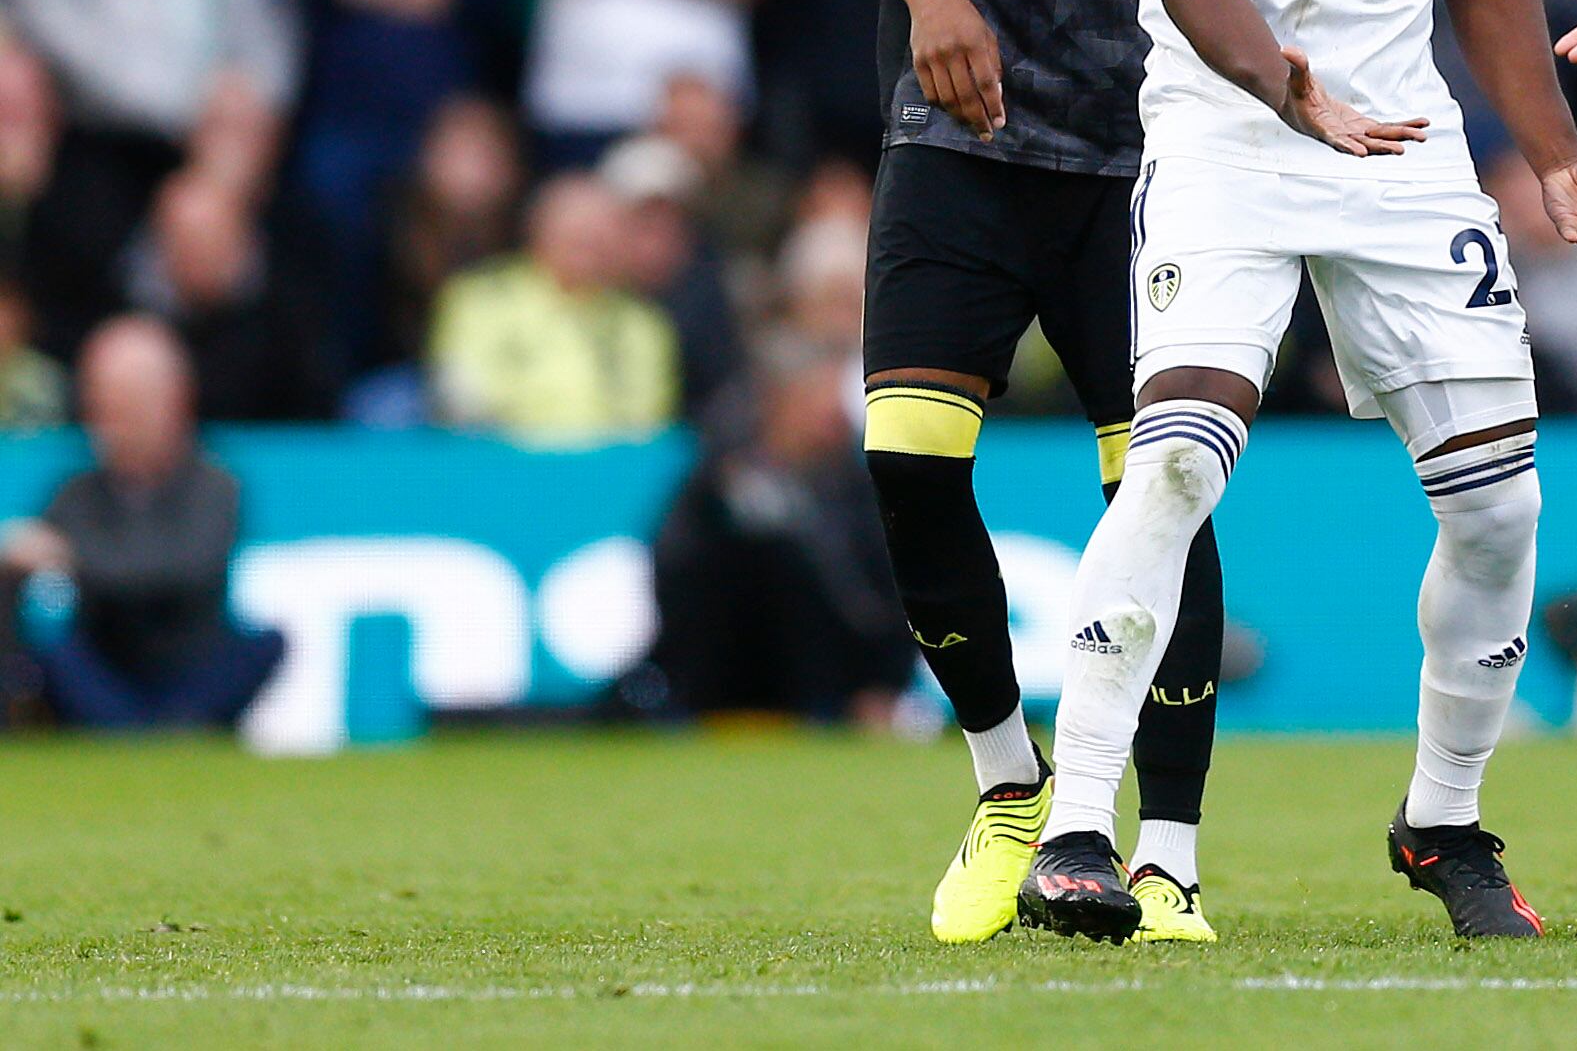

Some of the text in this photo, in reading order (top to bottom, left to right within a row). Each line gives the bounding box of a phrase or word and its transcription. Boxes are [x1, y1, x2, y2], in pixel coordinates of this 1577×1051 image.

[1449, 221, 1519, 309] 2
[1071, 640, 1122, 654] addas
[1150, 680, 1215, 706] ILLA
